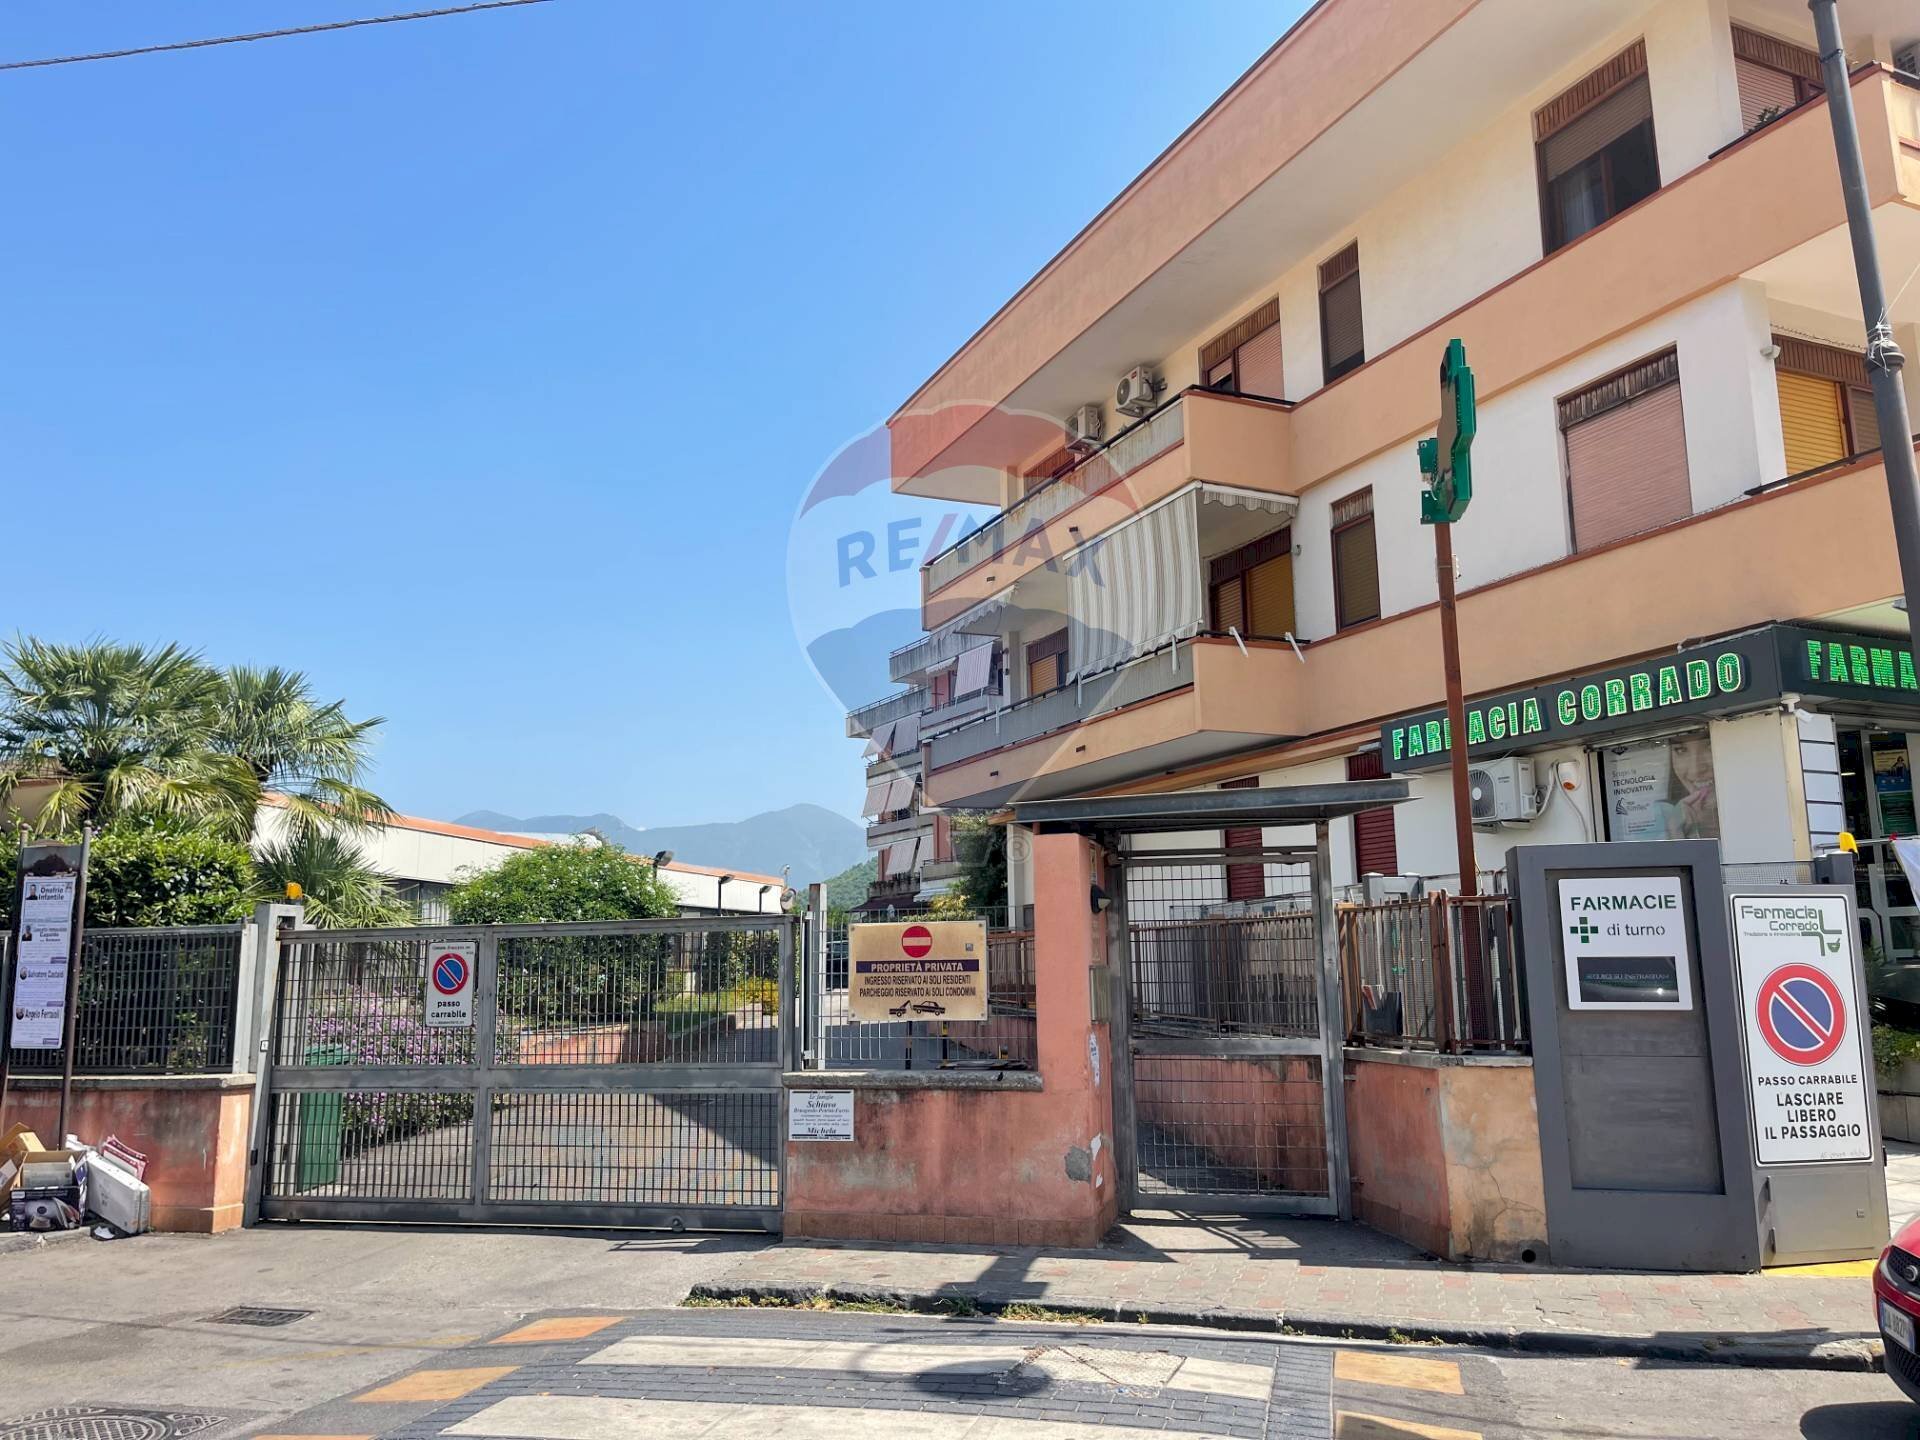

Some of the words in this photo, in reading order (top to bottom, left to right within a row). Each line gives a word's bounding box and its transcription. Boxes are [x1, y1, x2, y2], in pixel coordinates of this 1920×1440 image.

[1392, 697, 1542, 760] FARACIA
[1557, 652, 1742, 726] CORRADO
[1612, 775, 1656, 787] TECNOLOGIA
[1613, 784, 1654, 796] INNOVATIVA
[1570, 895, 1677, 911] FARMACIE
[1741, 905, 1818, 919] Farmacia
[1607, 923, 1620, 936] di
[1625, 923, 1666, 936] turno
[1769, 921, 1819, 931] Corrado
[871, 960, 922, 972] PROPRIETÀ
[924, 962, 964, 972] PRIVATA
[864, 975, 892, 985] INGRESSO
[893, 975, 922, 985] RISERVATO
[922, 975, 929, 984] AI
[929, 975, 942, 984] SOLI
[942, 975, 971, 984] RESIDENTI
[859, 988, 894, 997] PARCHEGGIO
[895, 987, 924, 997] RISERVATO
[924, 987, 931, 996] AI
[932, 987, 945, 996] SOLI
[945, 987, 976, 996] CONDOMINI
[431, 1010, 467, 1018] carrabile
[1758, 1076, 1796, 1086] PASSO
[1798, 1074, 1858, 1085] CARRABILE
[1776, 1092, 1844, 1106] LASCIARE
[1787, 1109, 1836, 1122] LIBERO
[1765, 1126, 1777, 1140] IL
[1781, 1124, 1861, 1139] PASSAGGIO
